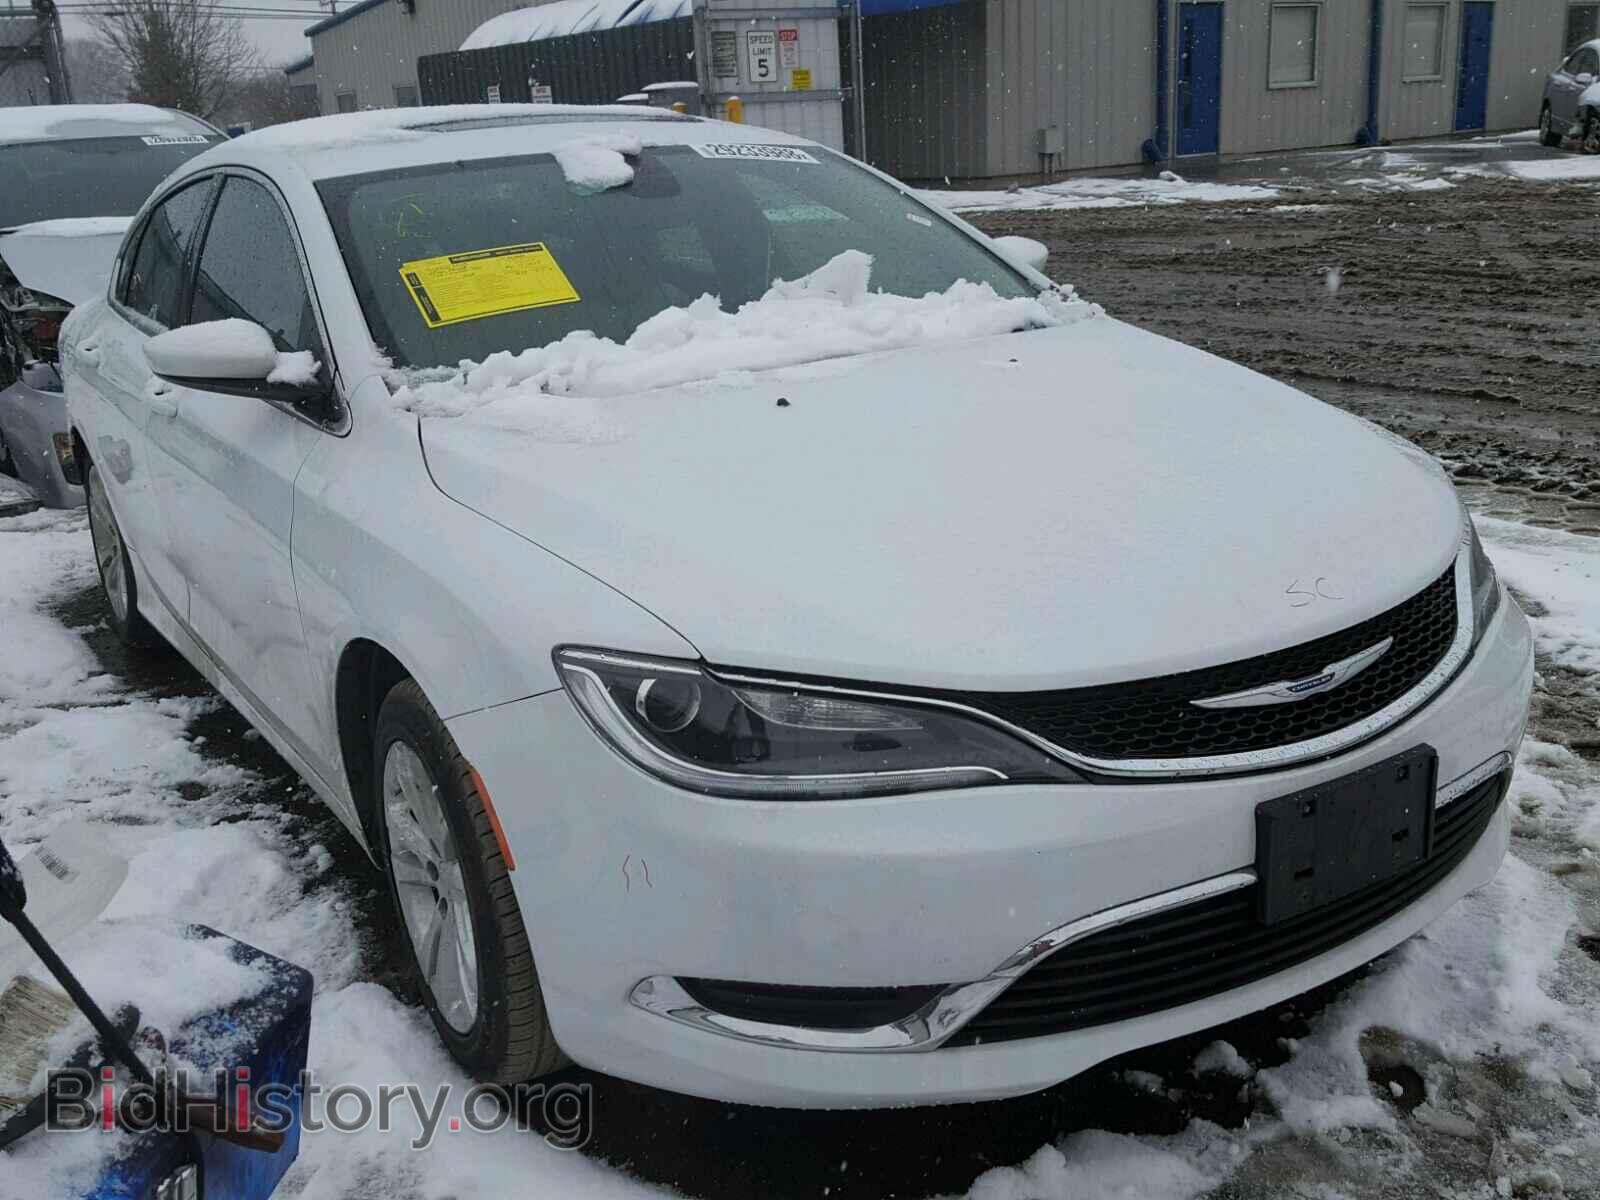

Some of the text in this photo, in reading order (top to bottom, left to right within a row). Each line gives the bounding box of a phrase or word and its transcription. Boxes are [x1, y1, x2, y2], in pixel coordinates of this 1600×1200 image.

[749, 35, 773, 44] SPEED
[780, 31, 797, 41] STOP
[752, 47, 772, 56] LIMIT
[758, 58, 769, 77] 5
